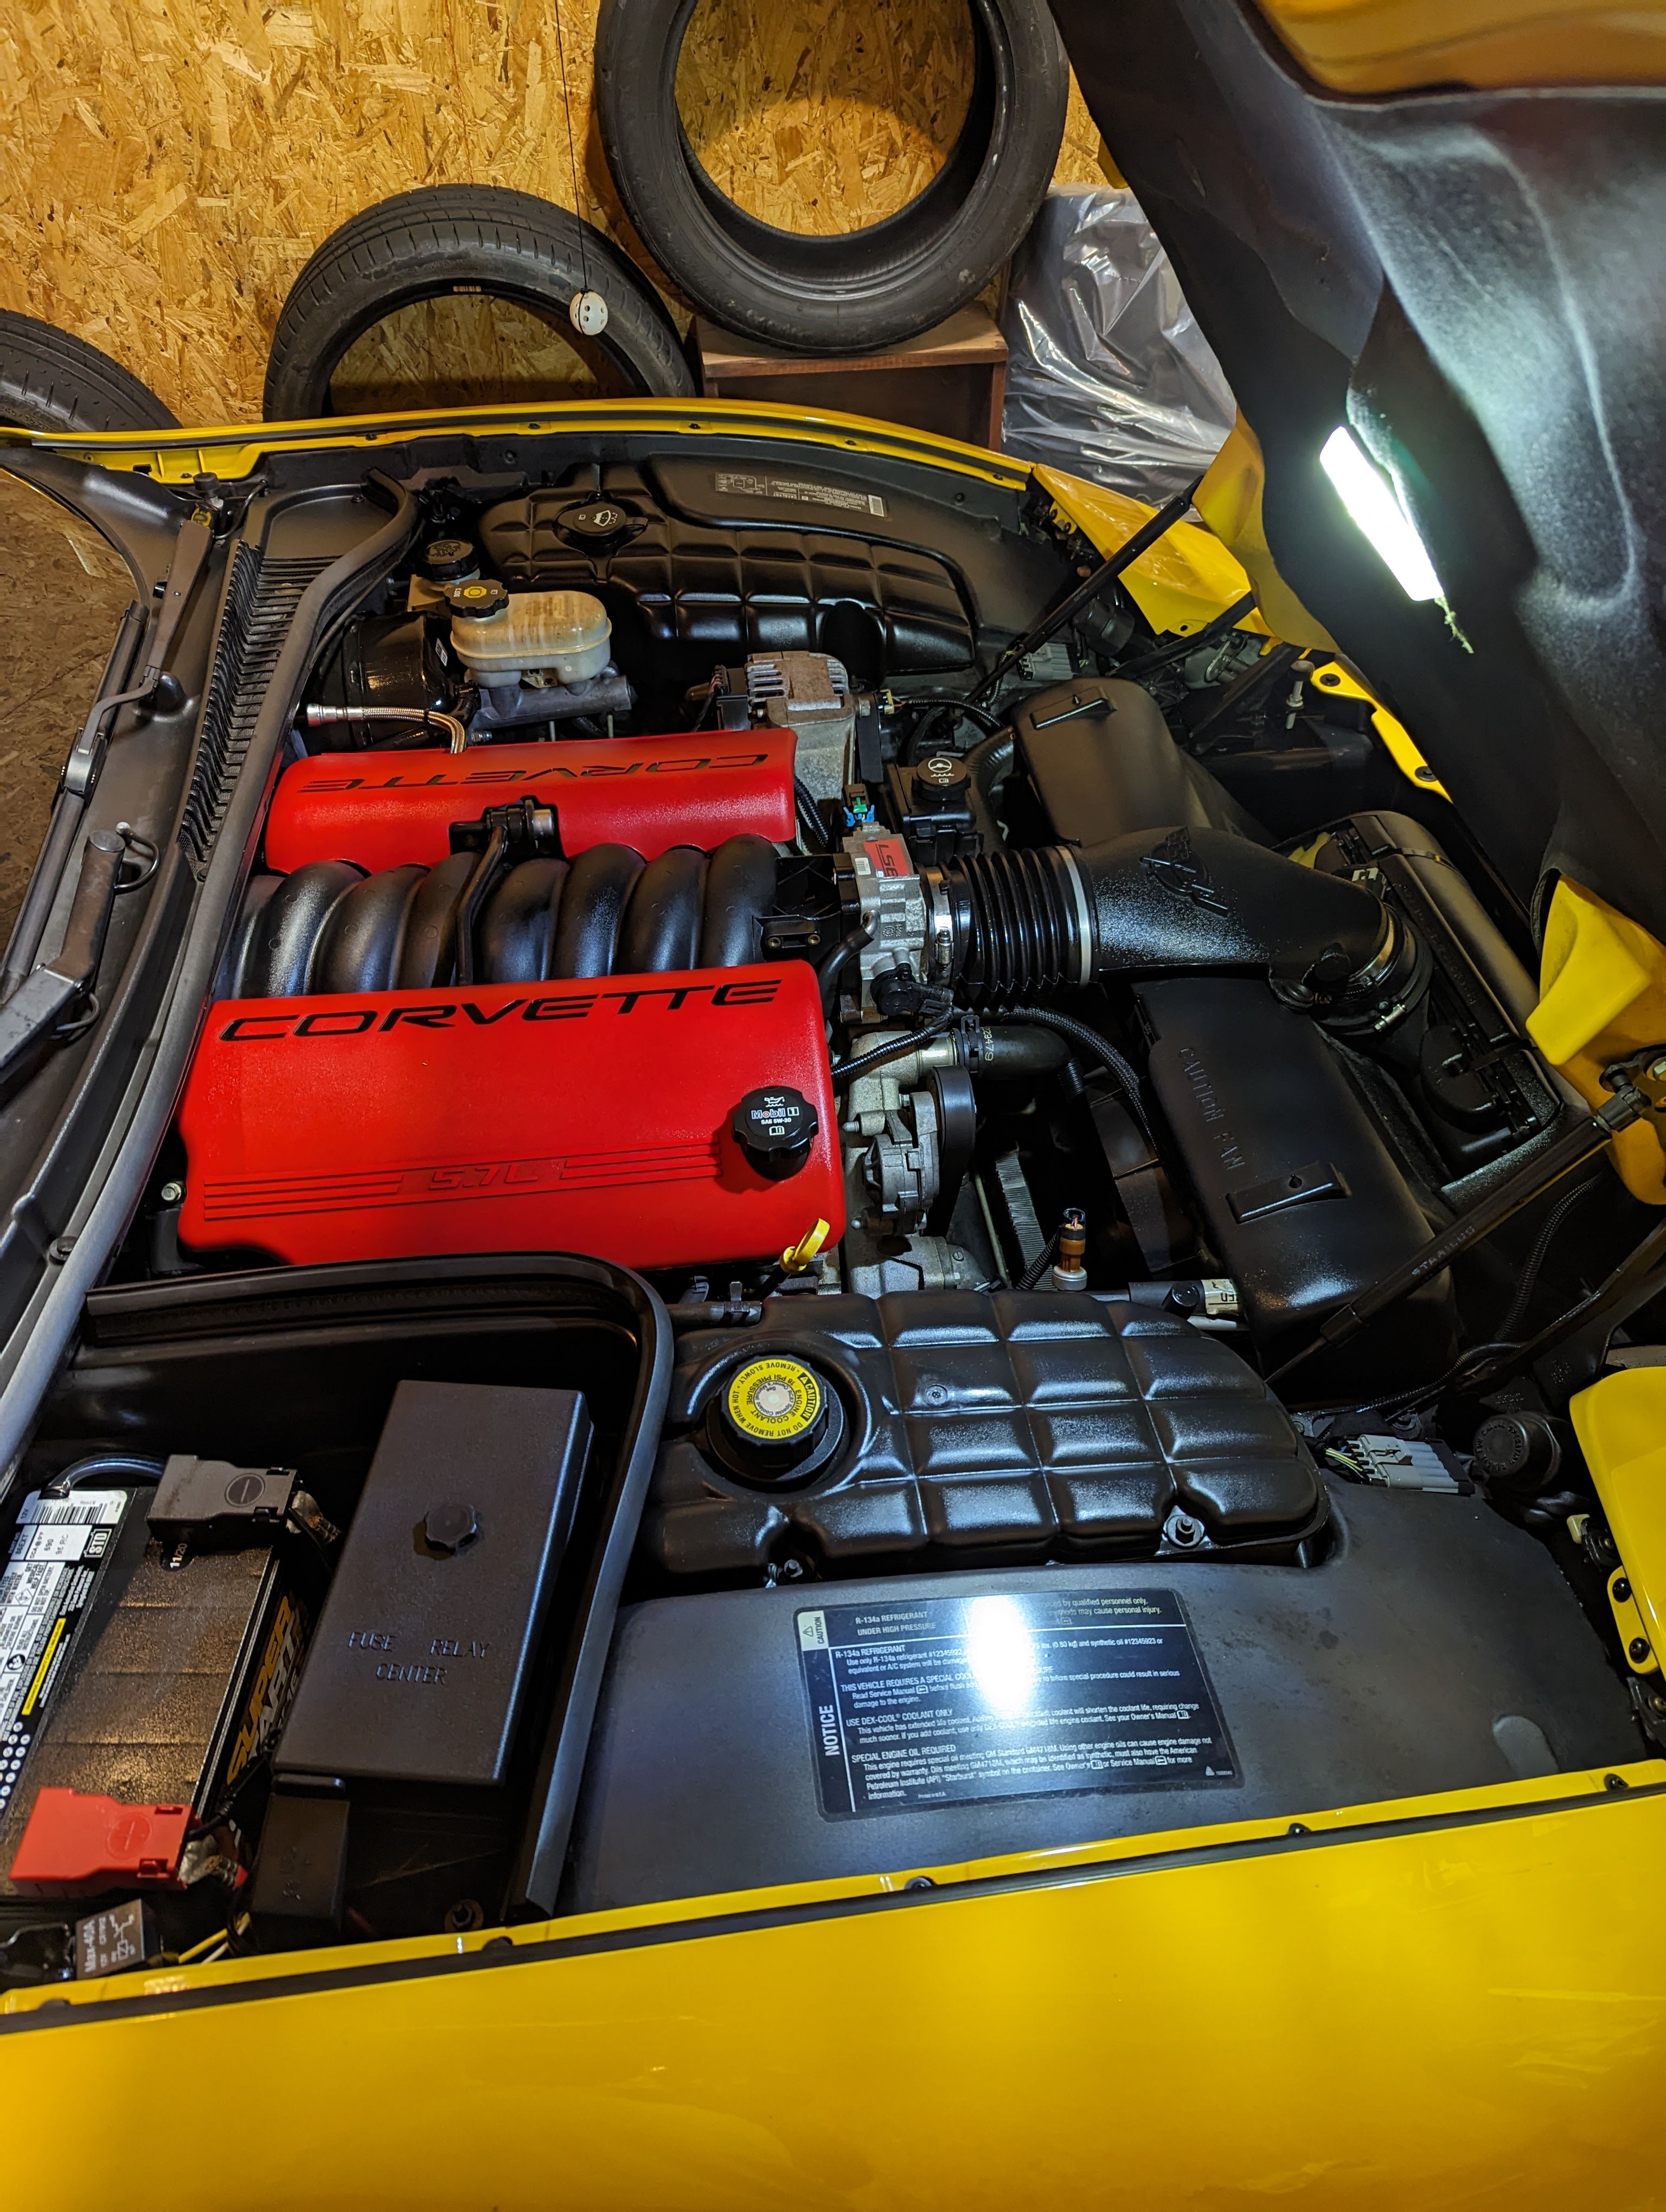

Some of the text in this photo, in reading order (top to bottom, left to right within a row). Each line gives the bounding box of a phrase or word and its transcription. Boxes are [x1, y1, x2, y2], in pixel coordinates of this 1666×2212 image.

[298, 754, 768, 794] CORVETTE
[219, 978, 783, 1042] CORVETTE
[751, 1108, 786, 1120] Mobil
[1178, 1047, 1246, 1171] CAUTION FAN
[428, 1163, 538, 1191] 5.7L
[739, 1362, 796, 1384] REMOVE SLOWLY
[746, 1375, 772, 1405] PRESSURE
[755, 1384, 767, 1400] Manual
[768, 1381, 789, 1390] Owner's
[755, 1401, 792, 1416] Special Coolant
[802, 1383, 817, 1419] CAUTION
[732, 1405, 747, 1424] WHEN
[750, 1409, 790, 1424] COOLANT
[745, 1422, 774, 1437] REMOVE
[777, 1427, 792, 1437] NOT
[793, 1422, 804, 1430] DO
[20, 1508, 29, 1519] 12V
[42, 1538, 55, 1551] 690
[87, 1532, 106, 1554] STD
[170, 1542, 188, 1569] 11/20
[855, 1611, 928, 1624] R-134a REFRIGERANT
[816, 1616, 824, 1645] CAUTION
[856, 1622, 936, 1636] UNDER HIGH PRESSURE
[348, 1631, 490, 1659] FUSE RELAY
[835, 1644, 906, 1658] R-134a REFRIGERANT
[1090, 1639, 1117, 1648] synthetic
[847, 1665, 879, 1675] equivalent
[899, 1661, 921, 1670] system
[858, 1657, 872, 1666] only
[872, 1655, 896, 1663] R-134a
[896, 1652, 927, 1662] refrigerant
[375, 1662, 448, 1686] CENTER
[841, 1683, 857, 1692] THIS
[856, 1680, 885, 1690] VEHICLE
[886, 1677, 920, 1687] REQUIRES
[925, 1674, 953, 1683] SPECIAL
[1068, 1673, 1090, 1681] special
[1089, 1671, 1119, 1680] procedure
[226, 1595, 292, 1786] SUPER
[852, 1687, 915, 1700] Read Service Manual
[853, 1699, 879, 1709] damage
[886, 1697, 898, 1705] the
[845, 1708, 954, 1727] USE COOLANT ONLY
[857, 1726, 872, 1734] This
[872, 1724, 894, 1733] vehicle
[894, 1722, 907, 1731] has
[907, 1719, 935, 1729] extended
[1084, 1706, 1108, 1714] shorten
[1107, 1705, 1118, 1713] the
[1118, 1704, 1141, 1712] coolant
[1151, 1702, 1178, 1711] requiring
[1177, 1702, 1200, 1711] change
[906, 1731, 919, 1740] you
[1130, 1712, 1155, 1720] Owner's
[1154, 1711, 1177, 1719] Manual
[819, 1704, 840, 1757] NOTICE
[850, 1744, 957, 1764] SPECIAL ENGINE OIL REQUIRED
[863, 1762, 878, 1771] This
[878, 1760, 900, 1771] engine
[900, 1757, 927, 1767] requires
[926, 1755, 950, 1765] special
[984, 1750, 997, 1758] GM
[1077, 1742, 1094, 1750] other
[1093, 1741, 1115, 1750] engine
[1114, 1740, 1126, 1748] oils
[1138, 1739, 1157, 1747] cause
[1156, 1738, 1178, 1747] engine
[1176, 1737, 1202, 1746] damage
[864, 1771, 891, 1781] covered
[890, 1770, 900, 1779] by
[900, 1766, 930, 1778] warranty.
[930, 1765, 943, 1774] Oils
[1047, 1753, 1076, 1762] identified
[1084, 1751, 1115, 1760] synthetic,
[1114, 1750, 1131, 1758] must
[1130, 1748, 1144, 1757] also
[1143, 1748, 1159, 1756] have
[1169, 1746, 1198, 1754] American
[866, 1780, 899, 1791] Petroleum
[1010, 1766, 1021, 1775] the
[1021, 1764, 1052, 1774] container.
[1052, 1763, 1065, 1771] See
[1065, 1761, 1092, 1770] Owner's
[1109, 1758, 1133, 1767] Service
[1132, 1757, 1155, 1766] Manual
[1176, 1756, 1193, 1764] more
[867, 1789, 907, 1801] information.
